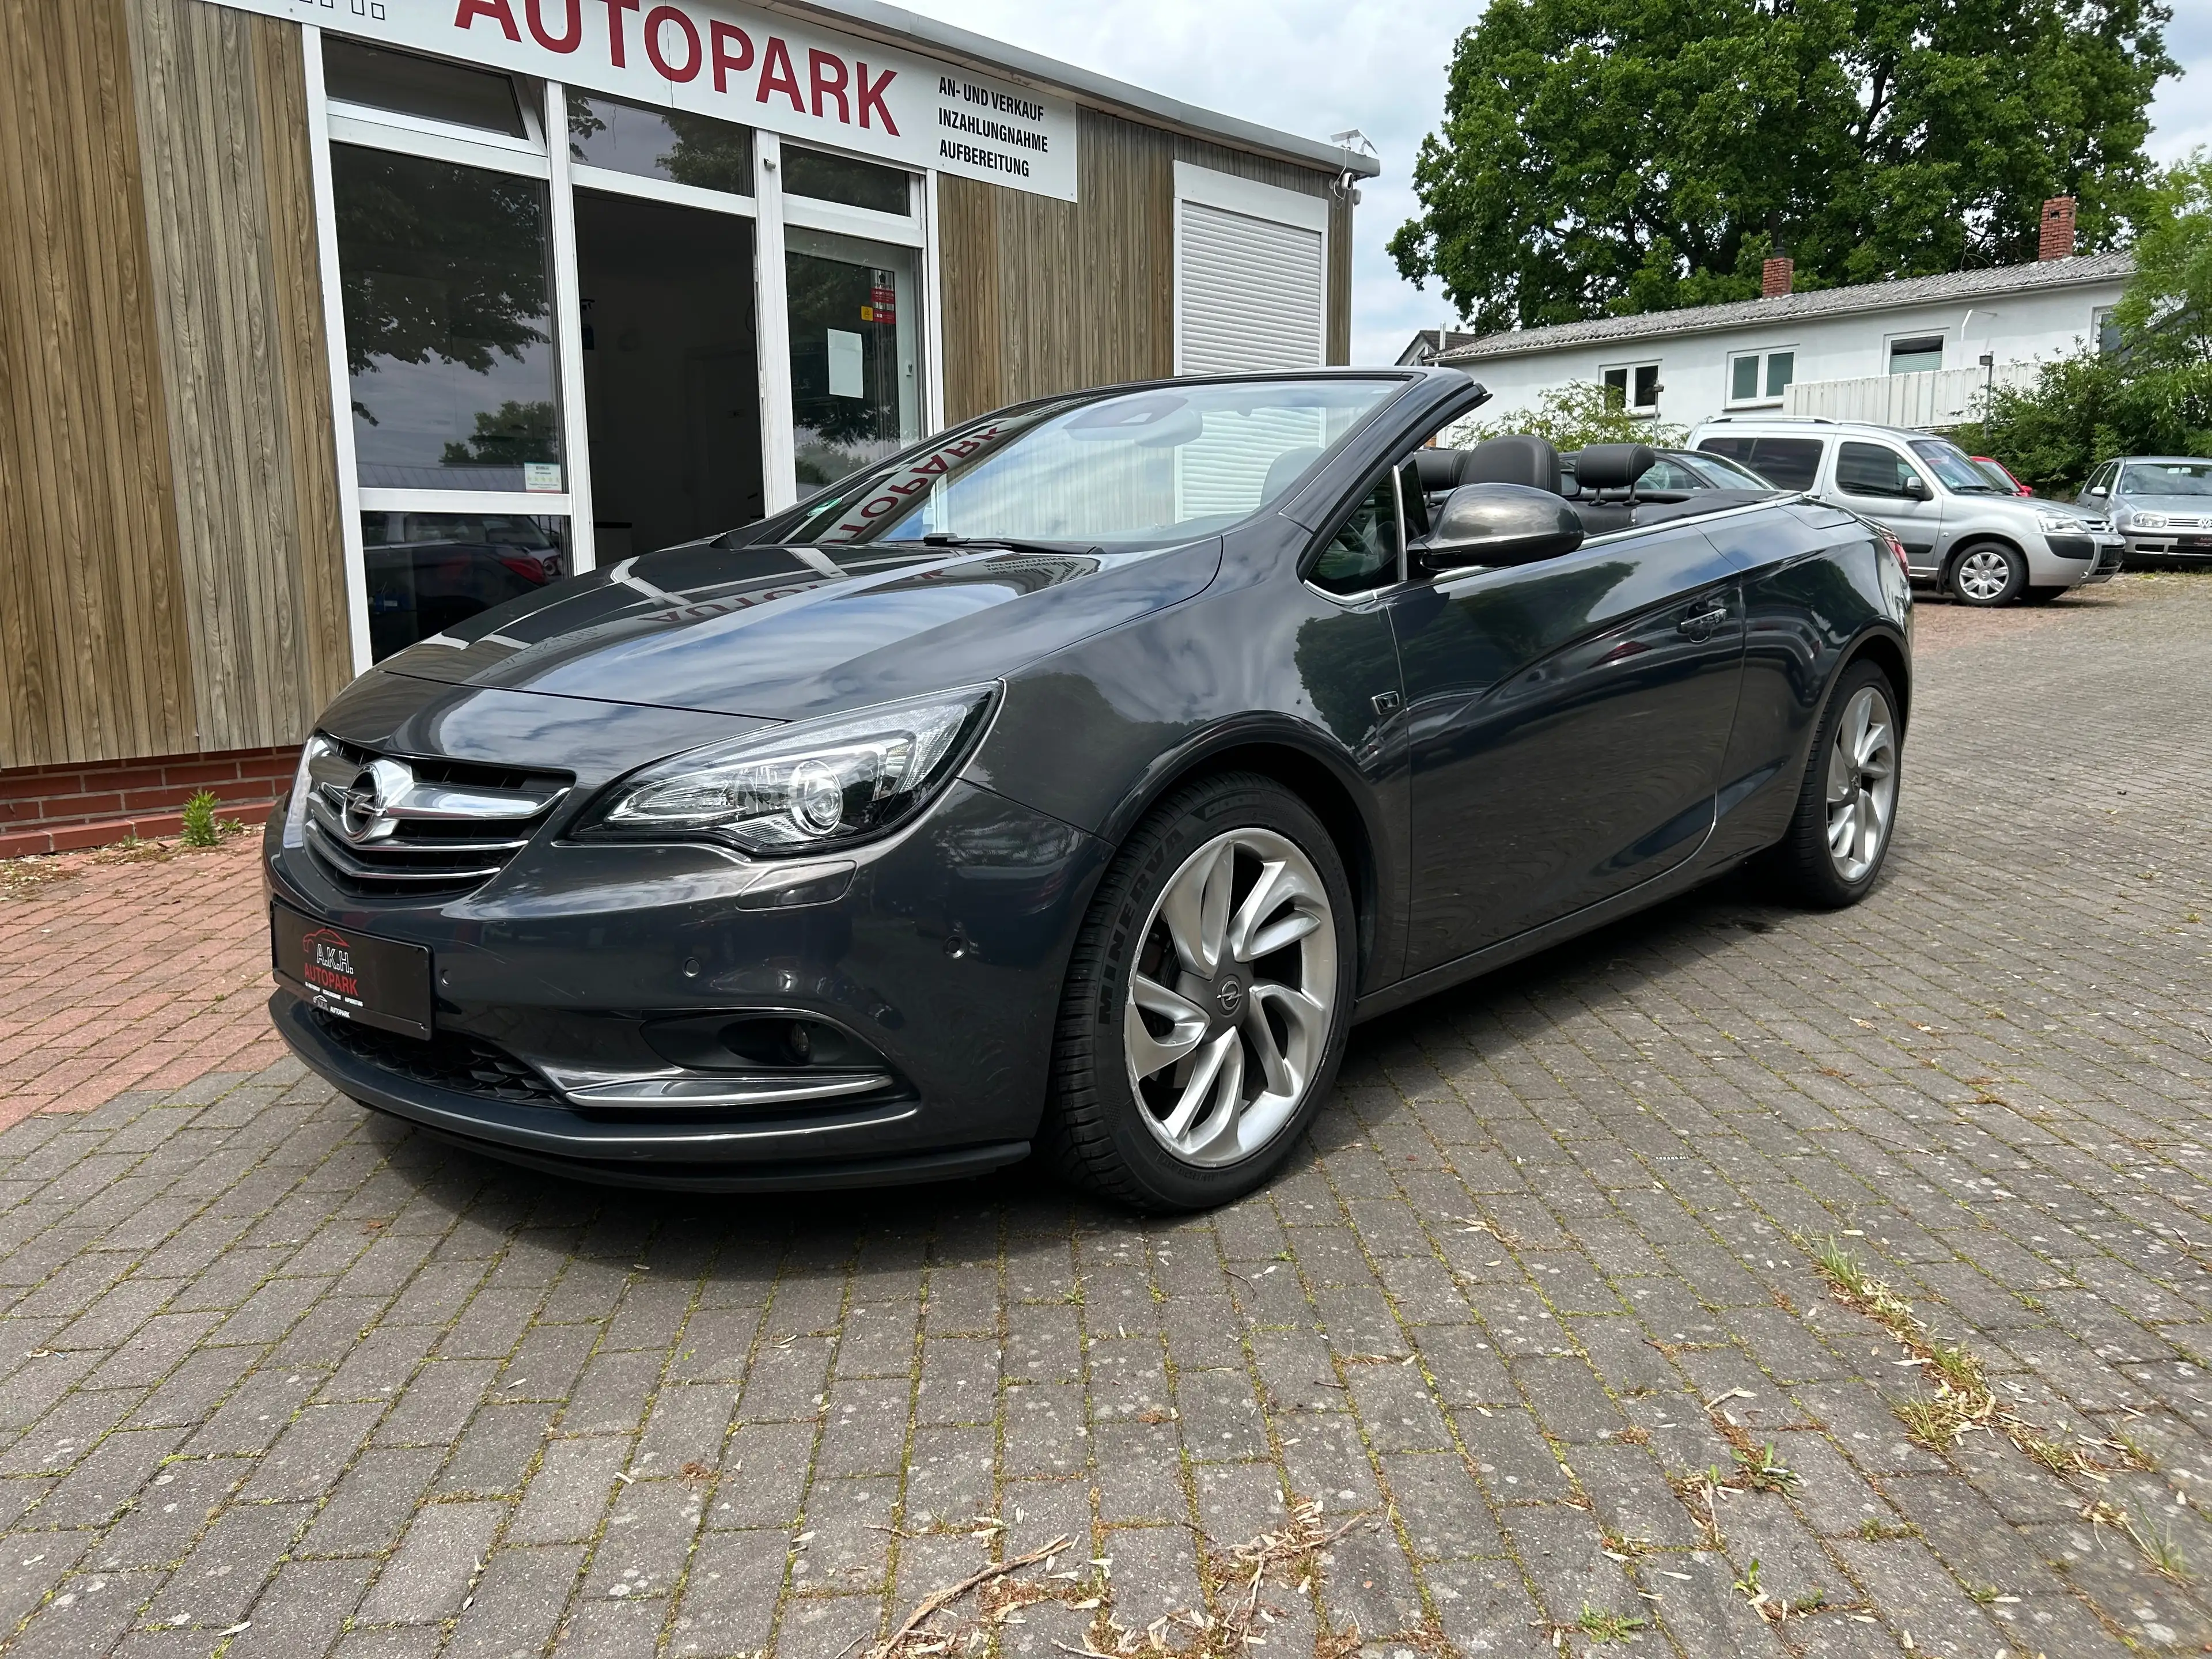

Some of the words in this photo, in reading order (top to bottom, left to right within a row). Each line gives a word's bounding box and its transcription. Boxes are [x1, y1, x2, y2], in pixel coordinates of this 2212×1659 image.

[939, 76, 960, 97] AN-
[964, 83, 988, 107] UND
[991, 92, 1044, 122] VERKAUF
[938, 107, 1048, 153] INZAHLUNGNAHME
[940, 139, 1030, 177] AUFBEREITUNG
[316, 944, 354, 975] A.K.H.
[305, 963, 359, 997] AUTOPARK
[329, 1006, 350, 1019] AUTOPARK
